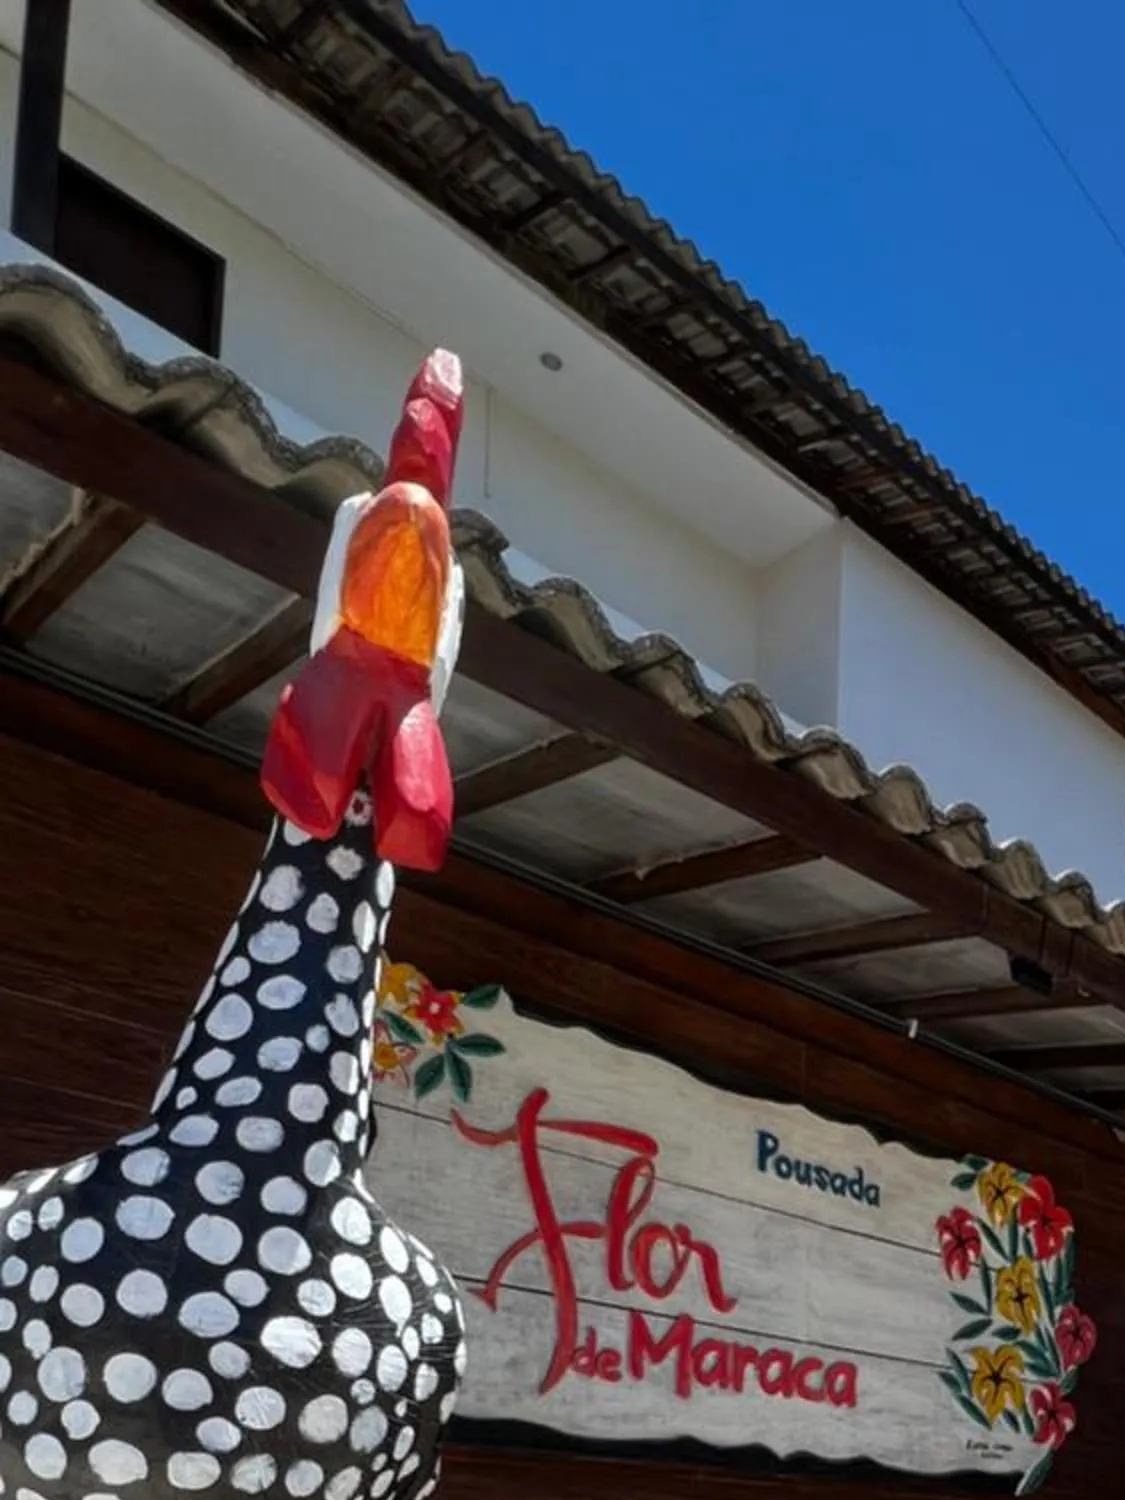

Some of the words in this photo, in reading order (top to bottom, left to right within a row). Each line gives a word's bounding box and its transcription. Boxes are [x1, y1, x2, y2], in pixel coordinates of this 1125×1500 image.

[756, 1130, 881, 1207] Pousada
[449, 1088, 738, 1396] Flor
[572, 1326, 623, 1384] de
[626, 1308, 859, 1409] Maraca
